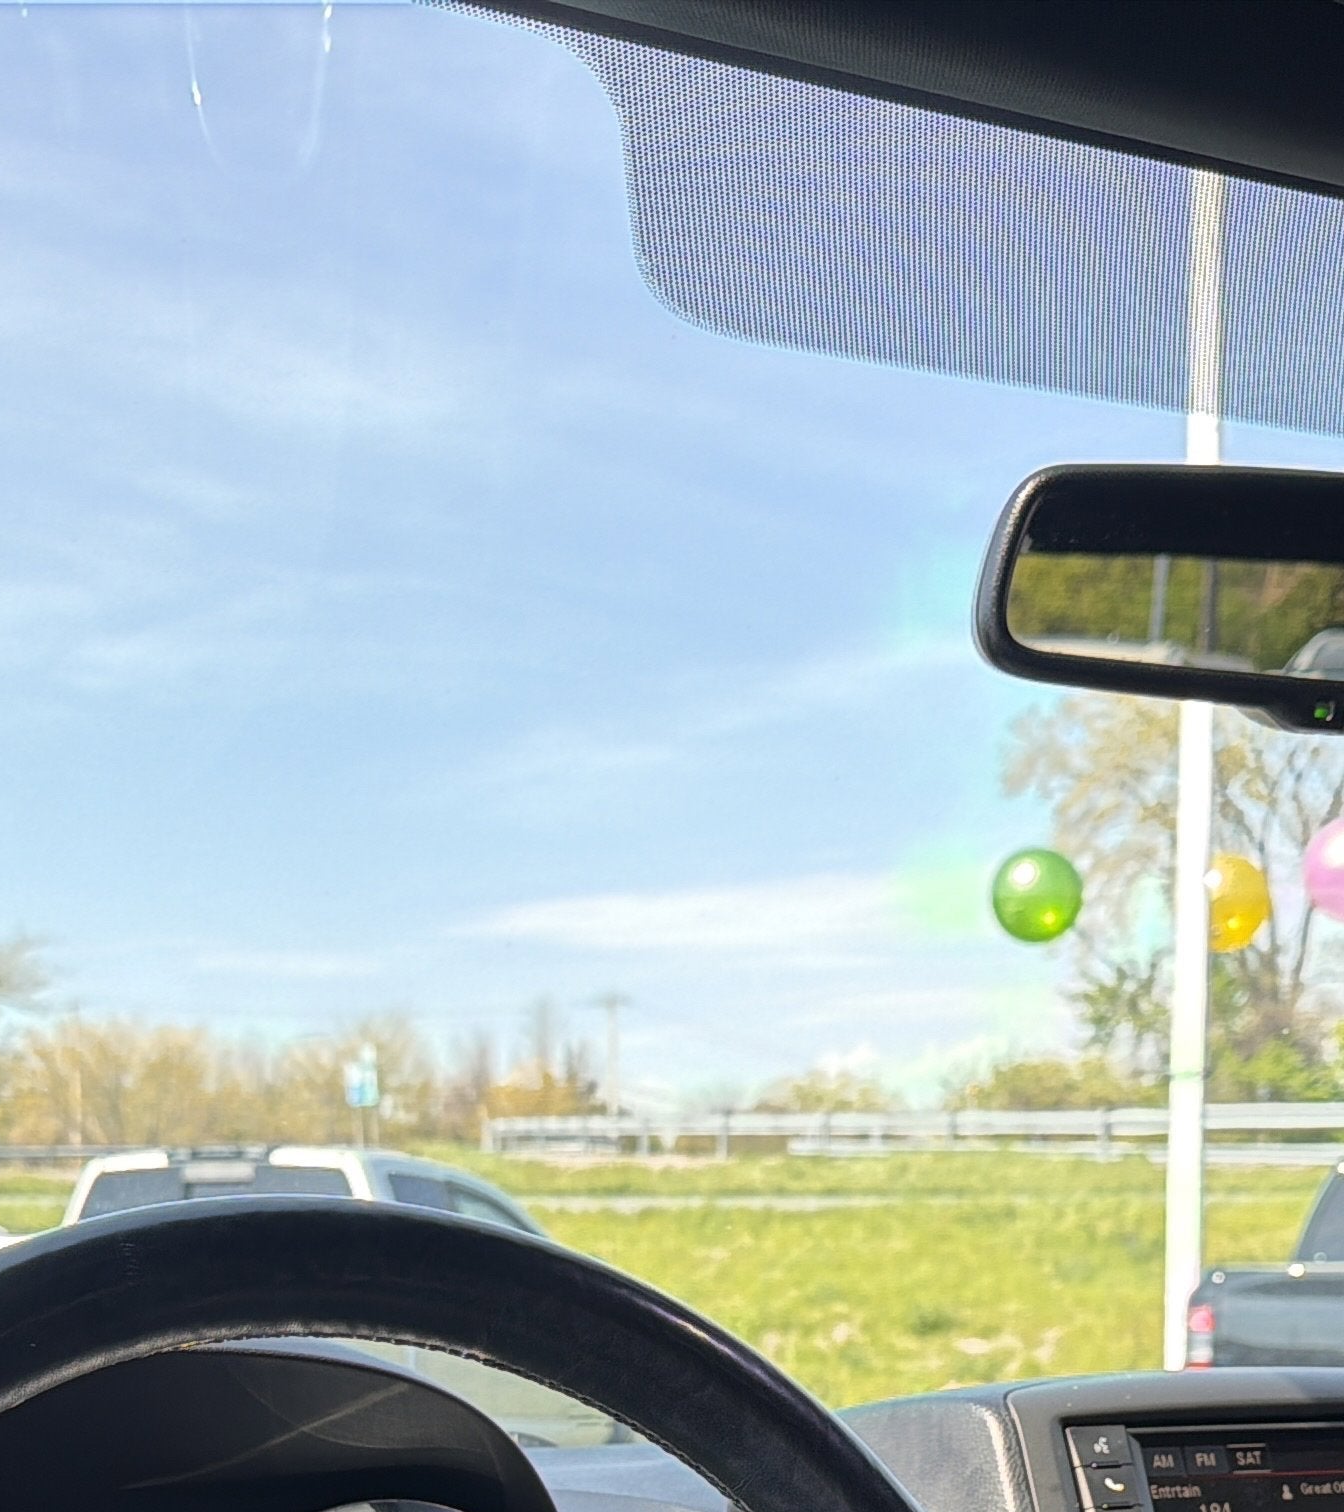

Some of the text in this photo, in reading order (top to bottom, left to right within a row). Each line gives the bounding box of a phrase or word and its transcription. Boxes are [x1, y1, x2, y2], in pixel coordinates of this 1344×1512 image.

[1152, 1451, 1262, 1468] AM FM SAT
[1300, 1482, 1332, 1495] Great
